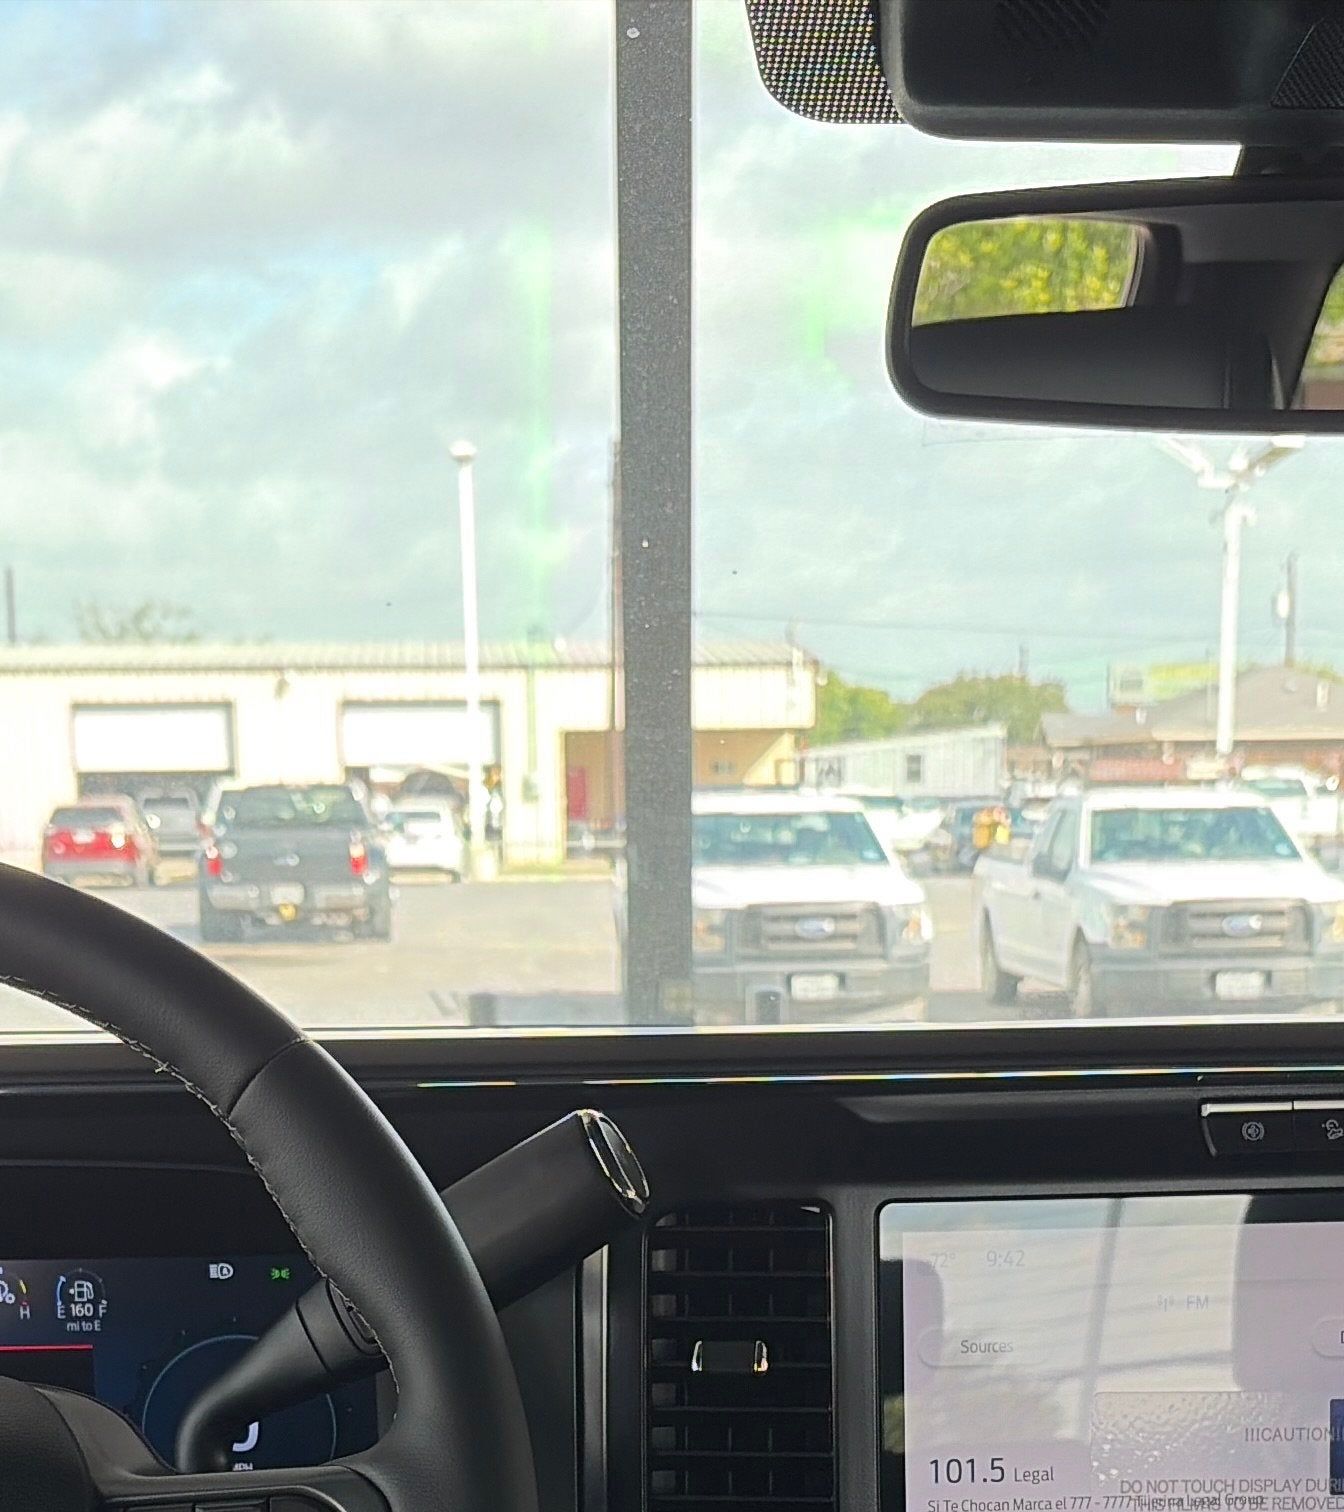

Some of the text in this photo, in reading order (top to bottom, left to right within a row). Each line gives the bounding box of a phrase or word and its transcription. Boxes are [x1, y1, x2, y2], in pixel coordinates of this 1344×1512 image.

[70, 1302, 94, 1317] 160
[1186, 1296, 1209, 1310] FM
[81, 1320, 93, 1332] to
[960, 1339, 1015, 1355] Sources
[929, 1457, 1055, 1485] 101.5 Legal
[1120, 1479, 1143, 1495] DO
[1146, 1479, 1179, 1494] NOT
[1181, 1478, 1235, 1494] TOUCH
[1239, 1478, 1302, 1493] DISPLAY
[943, 1499, 958, 1512] Te
[961, 1498, 1010, 1512] Chocan
[1013, 1497, 1053, 1512] Marca
[1055, 1496, 1067, 1511] el
[1070, 1496, 1092, 1510] 777
